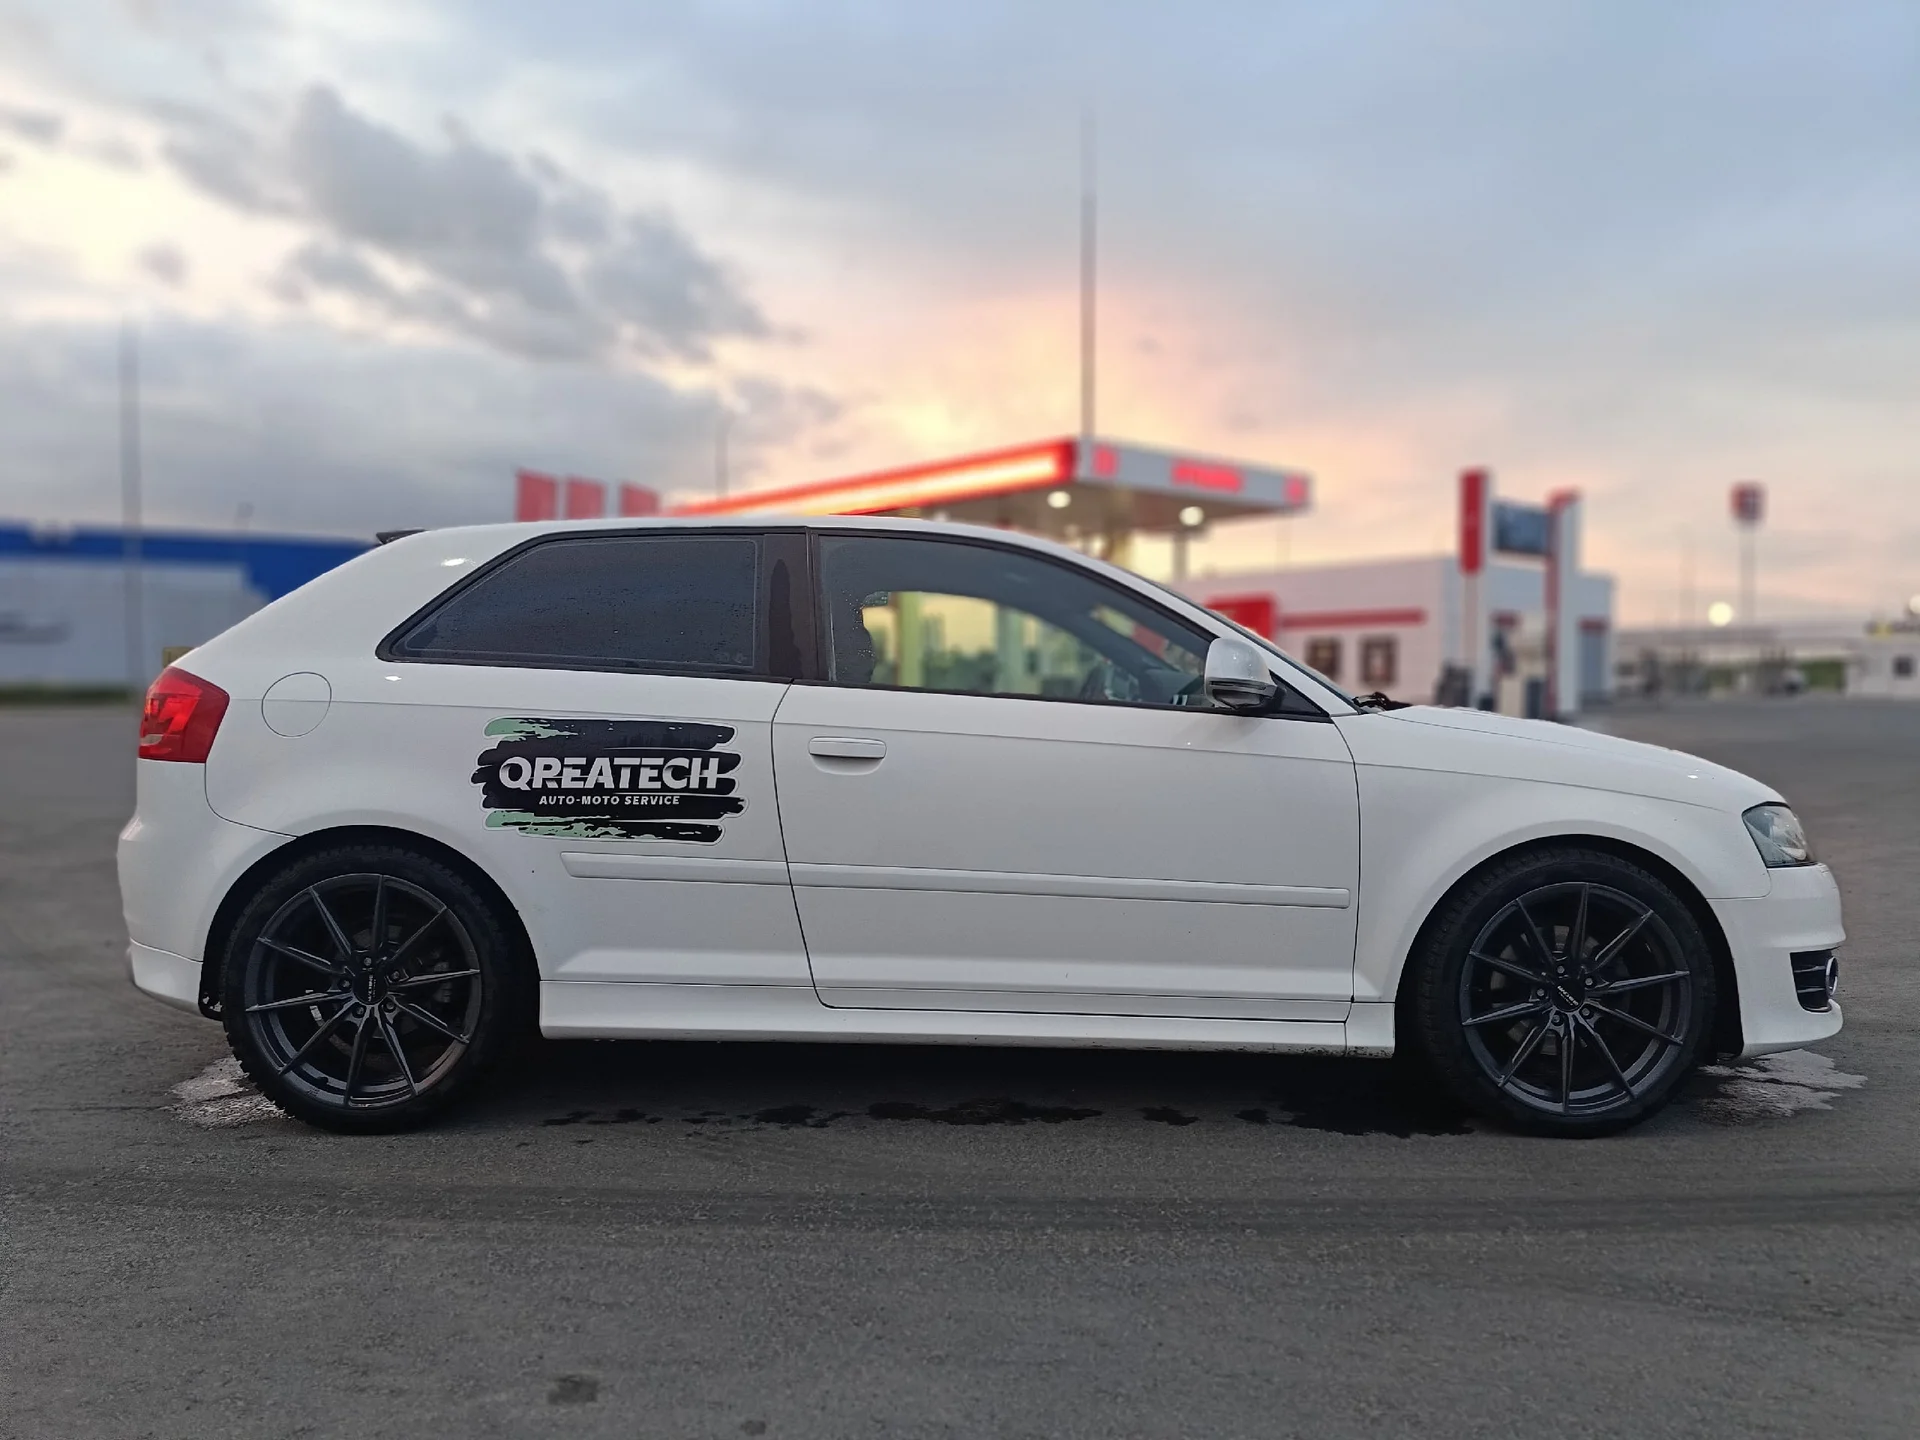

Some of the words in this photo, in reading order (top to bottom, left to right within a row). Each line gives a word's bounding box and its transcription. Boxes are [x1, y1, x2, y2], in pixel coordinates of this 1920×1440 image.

[499, 757, 719, 790] QREATECH
[539, 795, 620, 805] AUTO-MOTO
[624, 796, 680, 805] SERVICE
